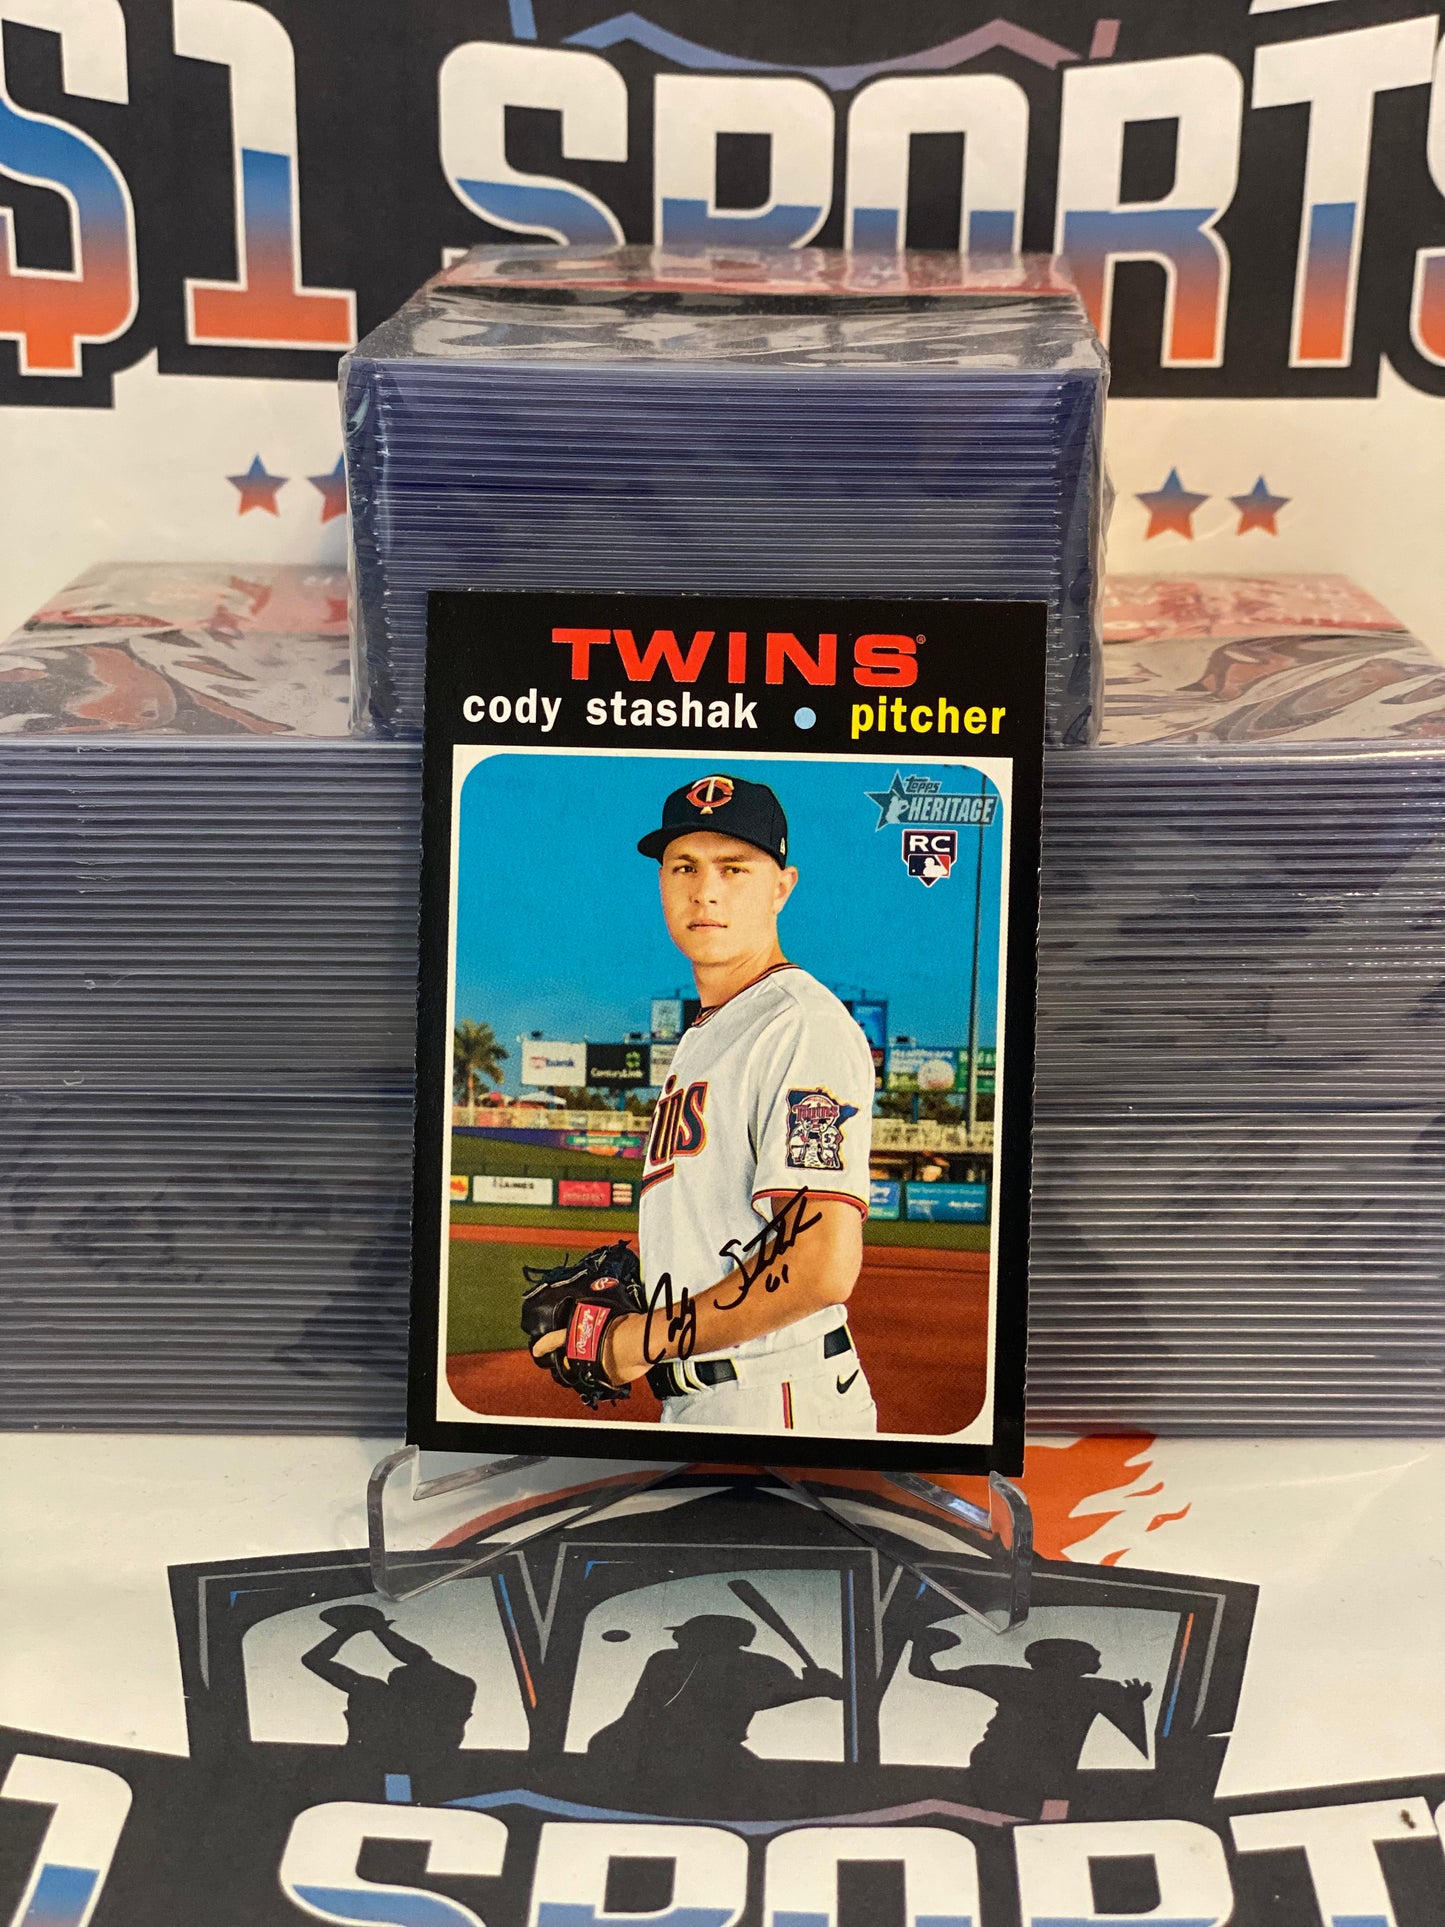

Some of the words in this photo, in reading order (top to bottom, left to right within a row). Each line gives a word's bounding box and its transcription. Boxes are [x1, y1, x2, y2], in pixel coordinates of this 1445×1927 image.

[438, 15, 1445, 369] SPORT
[462, 687, 562, 733] cody
[585, 690, 759, 729] stashak
[850, 696, 1006, 739] pitcher
[907, 796, 994, 823] HERITAGE
[908, 834, 951, 853] RC
